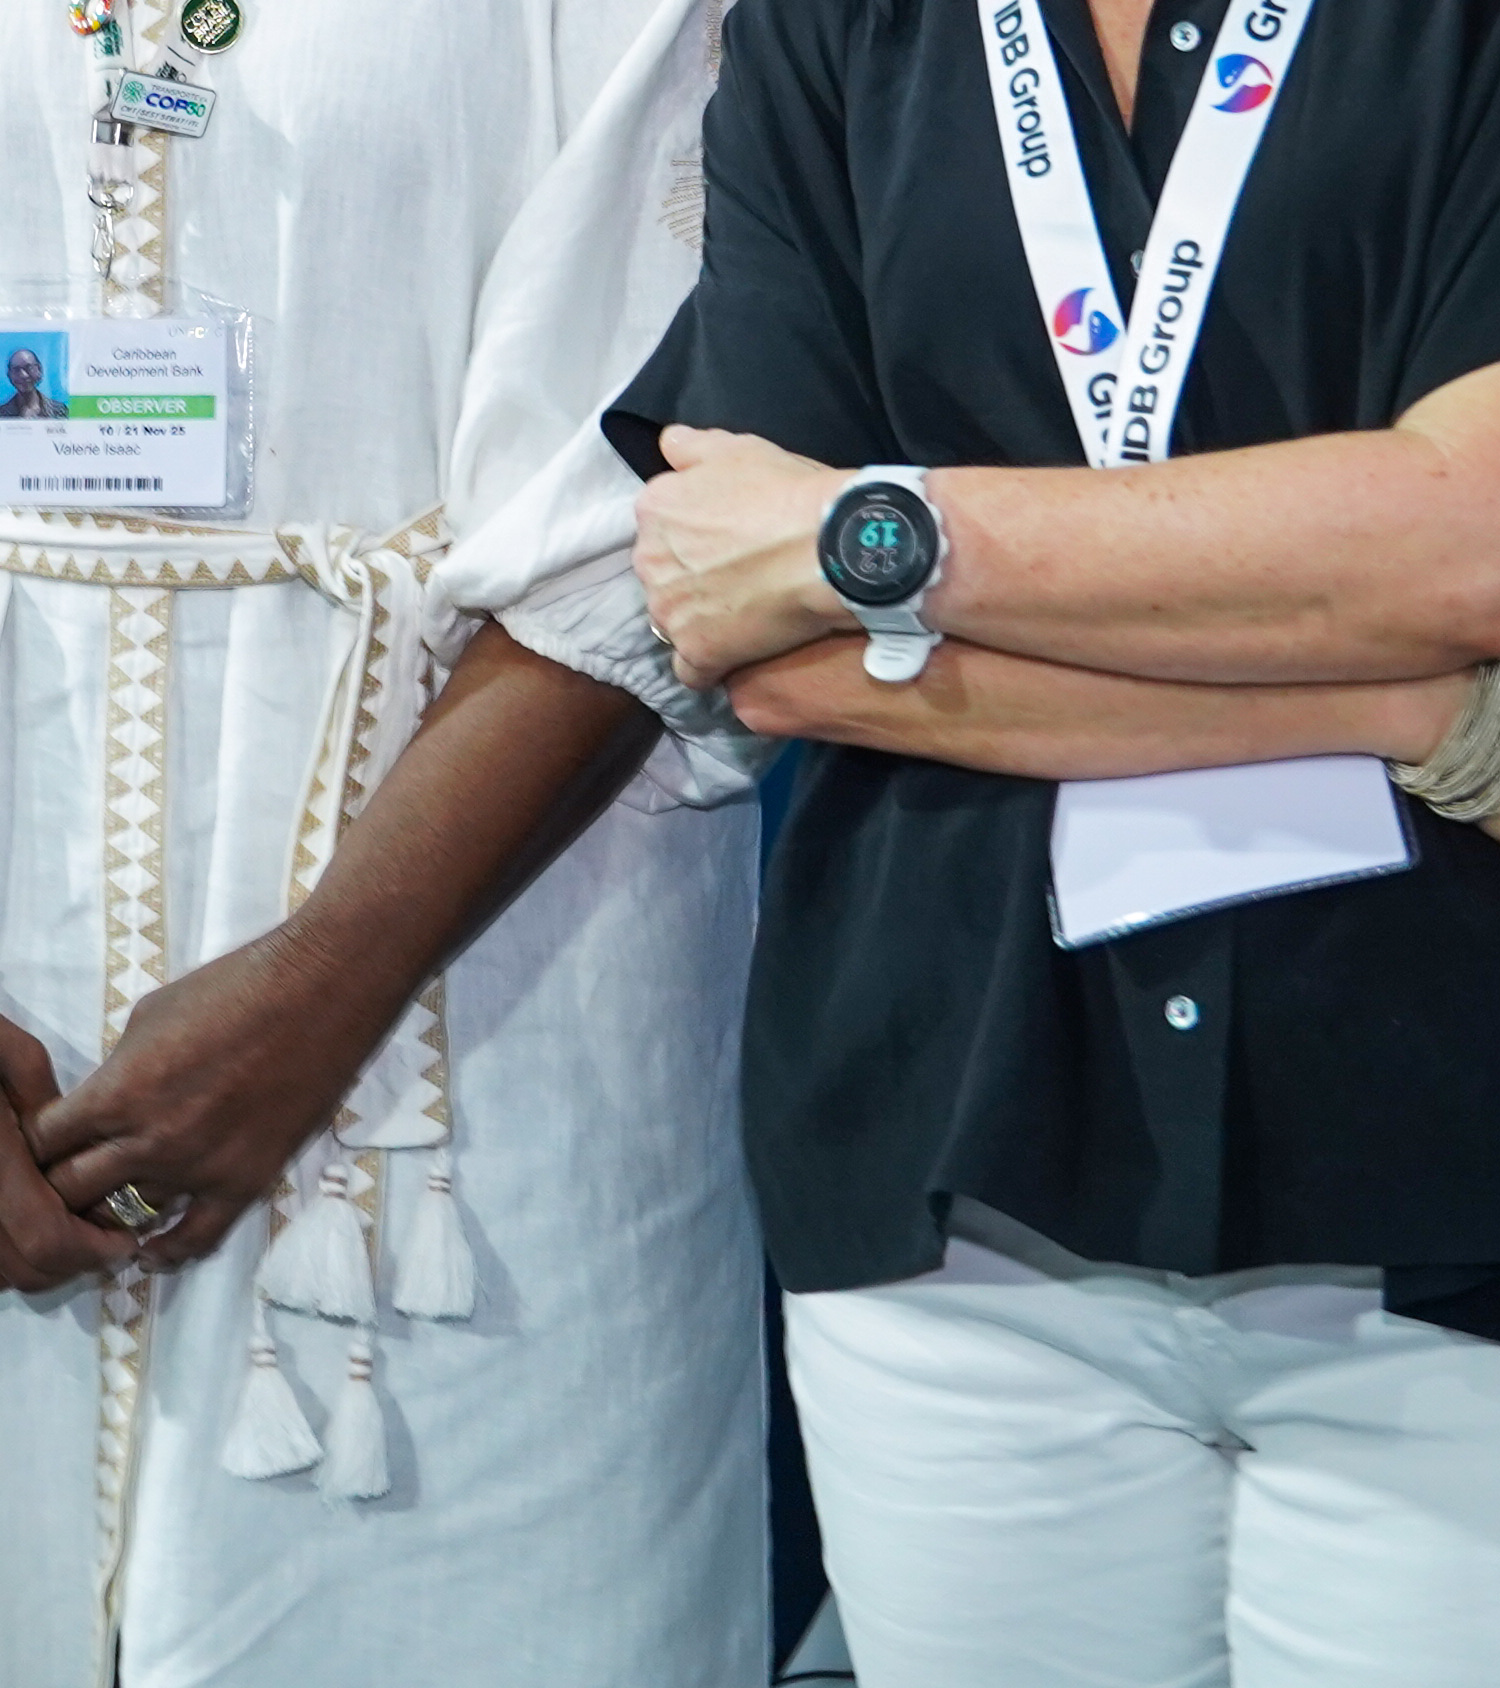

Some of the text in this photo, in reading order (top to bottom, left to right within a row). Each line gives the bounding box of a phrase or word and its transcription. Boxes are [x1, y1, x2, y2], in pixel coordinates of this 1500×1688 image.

[994, 0, 1051, 178] IDB Group
[146, 93, 206, 118] COP30
[112, 347, 177, 361] Caribbean
[1120, 238, 1203, 462] IDB Group
[86, 365, 204, 381] Development Bank
[97, 399, 187, 414] OBSERVER
[99, 426, 114, 437] 10
[125, 426, 139, 437] 21
[143, 426, 167, 437] Nov
[171, 426, 186, 436] 25
[52, 441, 142, 456] Valerie Isaac
